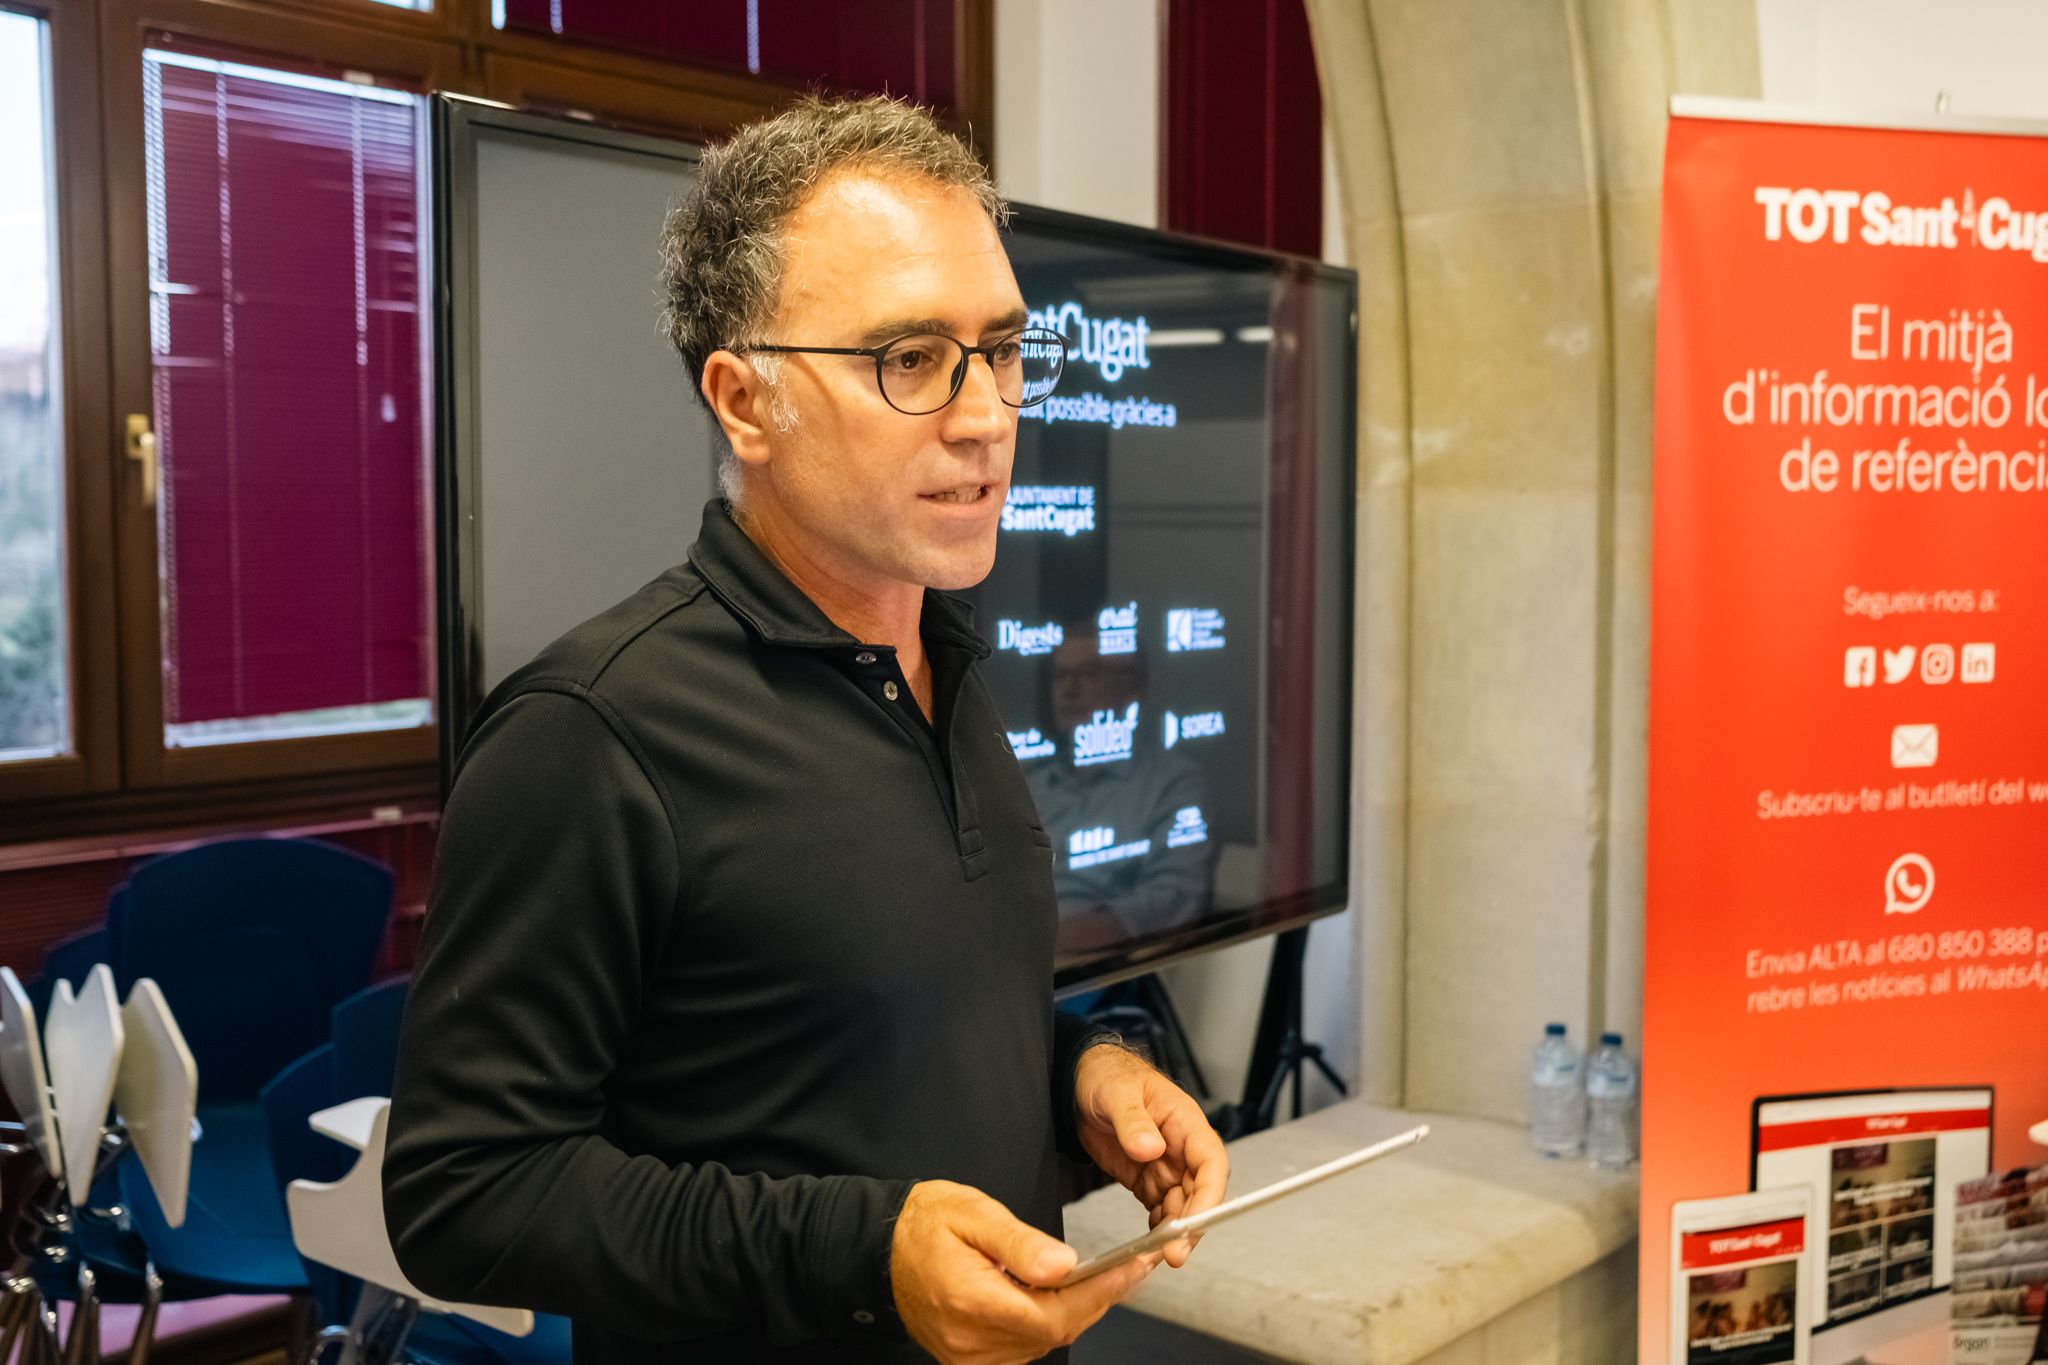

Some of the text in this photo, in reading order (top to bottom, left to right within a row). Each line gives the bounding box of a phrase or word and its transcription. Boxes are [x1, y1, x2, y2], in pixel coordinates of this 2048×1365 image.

[1754, 187, 1859, 243] TOT
[1851, 303, 2013, 374] El mitjà
[1046, 391, 1110, 425] possible
[1722, 368, 2012, 428] d'informació
[1779, 437, 2048, 493] de referènci
[1001, 504, 1095, 537] SantCugat
[1757, 786, 1881, 819] Subscriu-te
[1884, 783, 1905, 812] al
[1907, 778, 1987, 809] butlletí
[1988, 777, 2024, 805] del
[1746, 947, 1805, 979] Envia
[1807, 938, 1863, 971] ALTA
[1864, 937, 1885, 966] al
[1887, 933, 1935, 964] 680
[1936, 929, 1985, 961] 850
[1987, 926, 2034, 957] 388
[1747, 985, 1806, 1014] rebre
[1808, 981, 1840, 1007] les
[1842, 972, 1927, 1003] notícies
[1930, 967, 1951, 995] al
